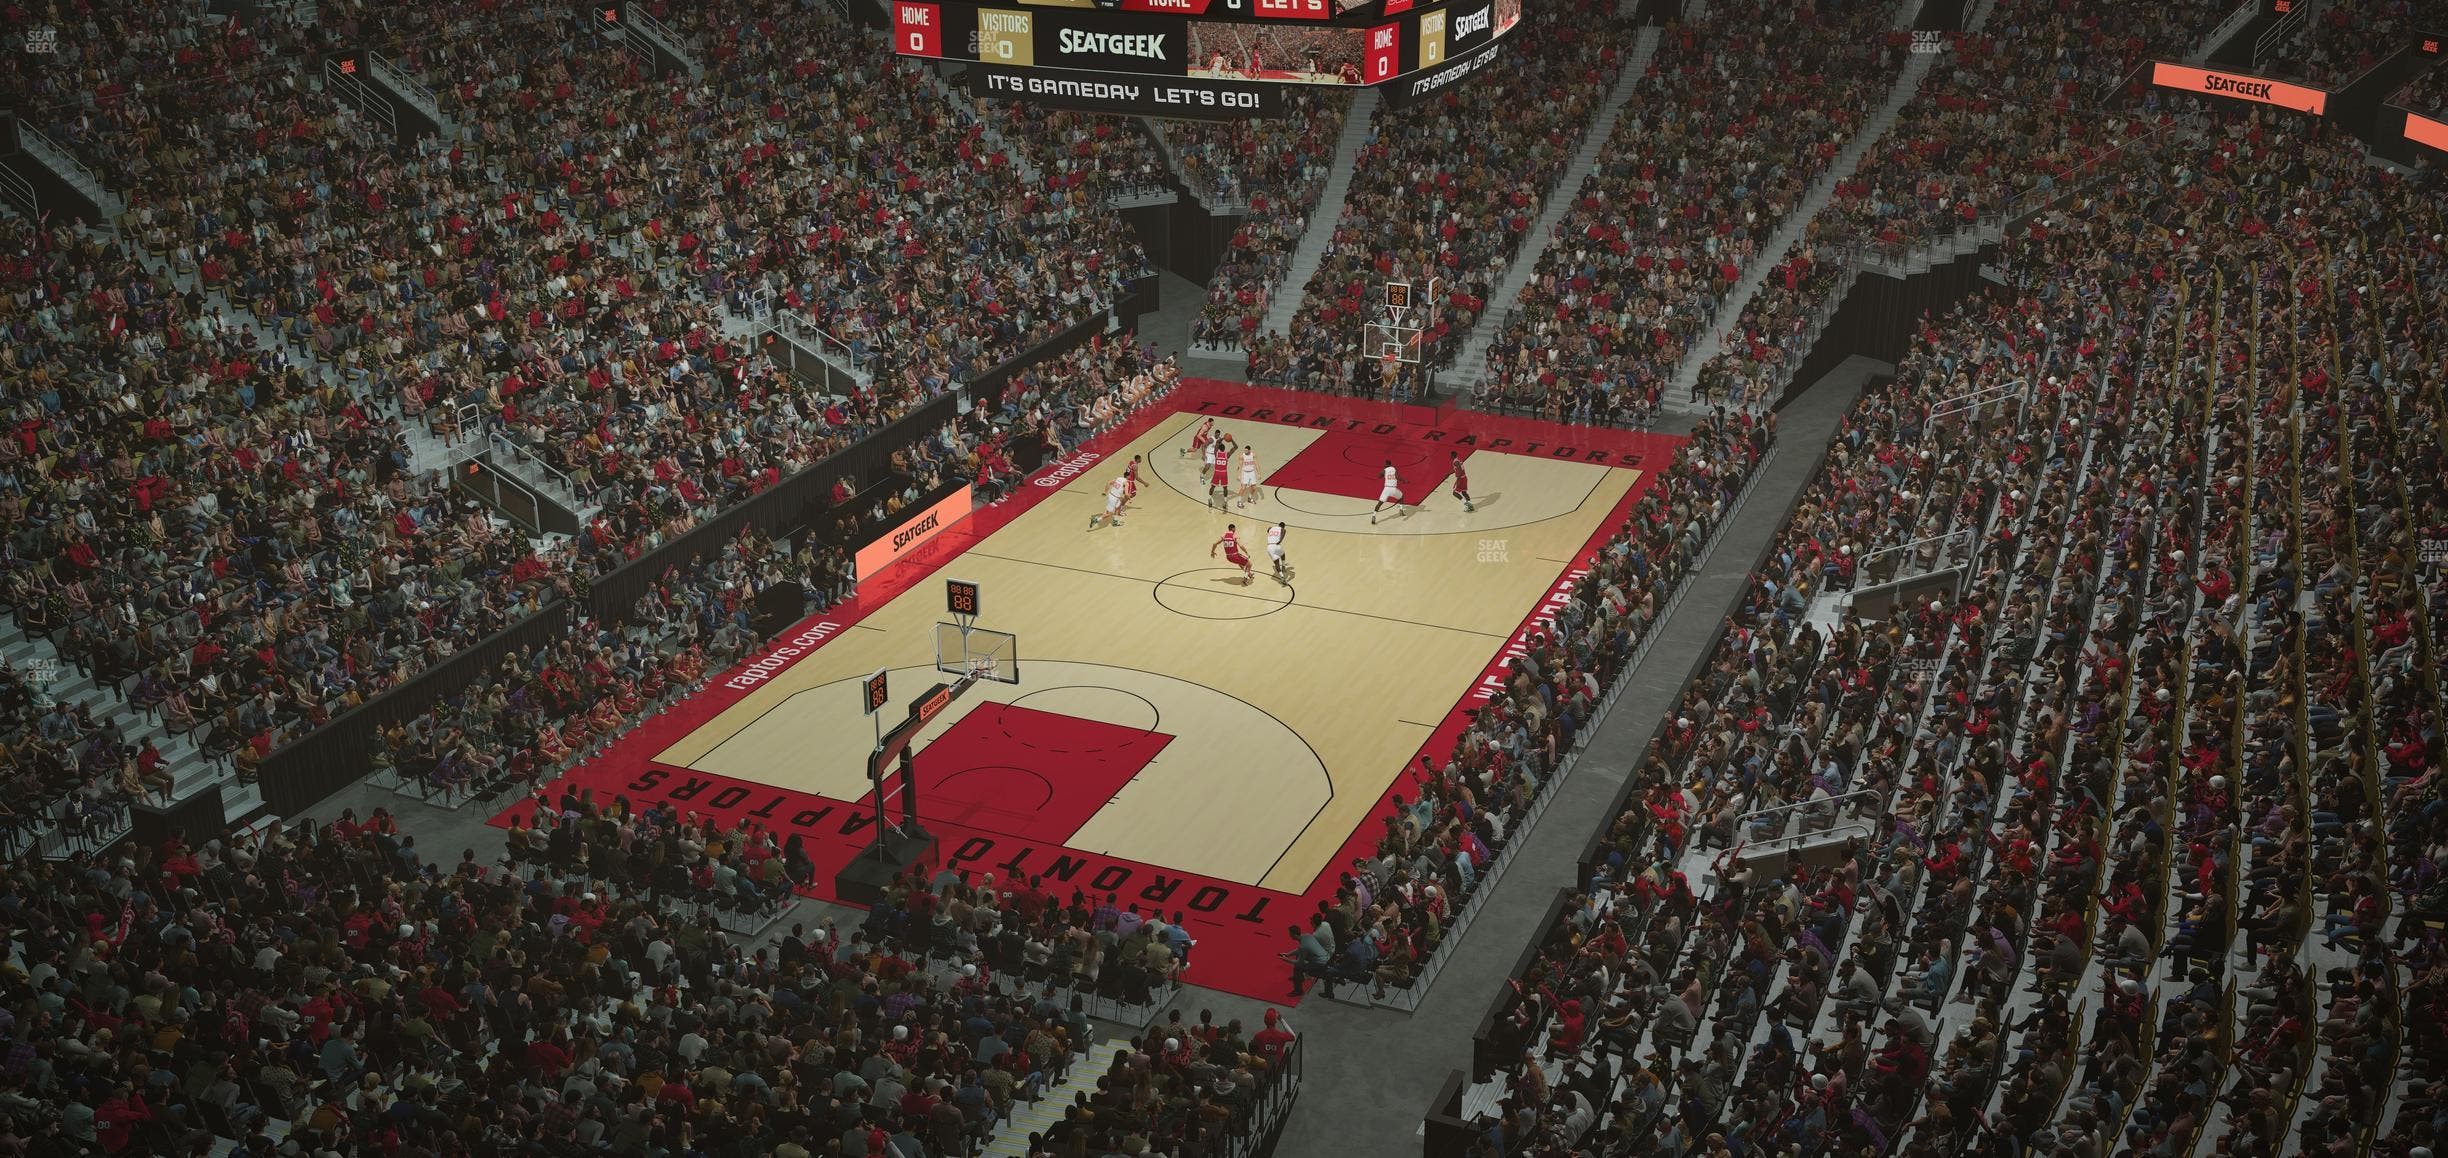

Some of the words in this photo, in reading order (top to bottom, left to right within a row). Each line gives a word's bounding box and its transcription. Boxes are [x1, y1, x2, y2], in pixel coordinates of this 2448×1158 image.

[902, 6, 930, 26] HOME
[982, 12, 1029, 34] VISITORS
[1422, 13, 1445, 36] VISITORS
[1455, 4, 1490, 41] SEATGEEK
[910, 32, 924, 51] 0
[999, 40, 1013, 59] 0
[1059, 28, 1167, 61] SEATGEEK
[1374, 28, 1393, 50] HOME
[1428, 41, 1436, 61] 0
[1378, 56, 1388, 76] 0
[1411, 77, 1430, 97] IT'S
[1430, 60, 1471, 89] GAMEDAY
[1472, 50, 1490, 71] LET'S
[1488, 44, 1499, 61] GO!
[988, 74, 1025, 92] IT'S
[1028, 77, 1139, 101] GAMEDAY
[1154, 87, 1215, 106] LET'S
[1221, 92, 1260, 108] GO!
[2205, 74, 2273, 100] SEATGEEK
[1196, 401, 1398, 435] TORONTO
[1421, 429, 1644, 466] RAPTORS
[1034, 451, 1101, 488] @raptors
[893, 509, 939, 553] SEATGEEK
[954, 595, 972, 611] 88
[724, 620, 841, 690] raptors.com
[872, 687, 884, 707] 88
[922, 694, 947, 716] SEATGEEK
[627, 770, 877, 835] APTORS
[951, 835, 1272, 924] TORONTO
